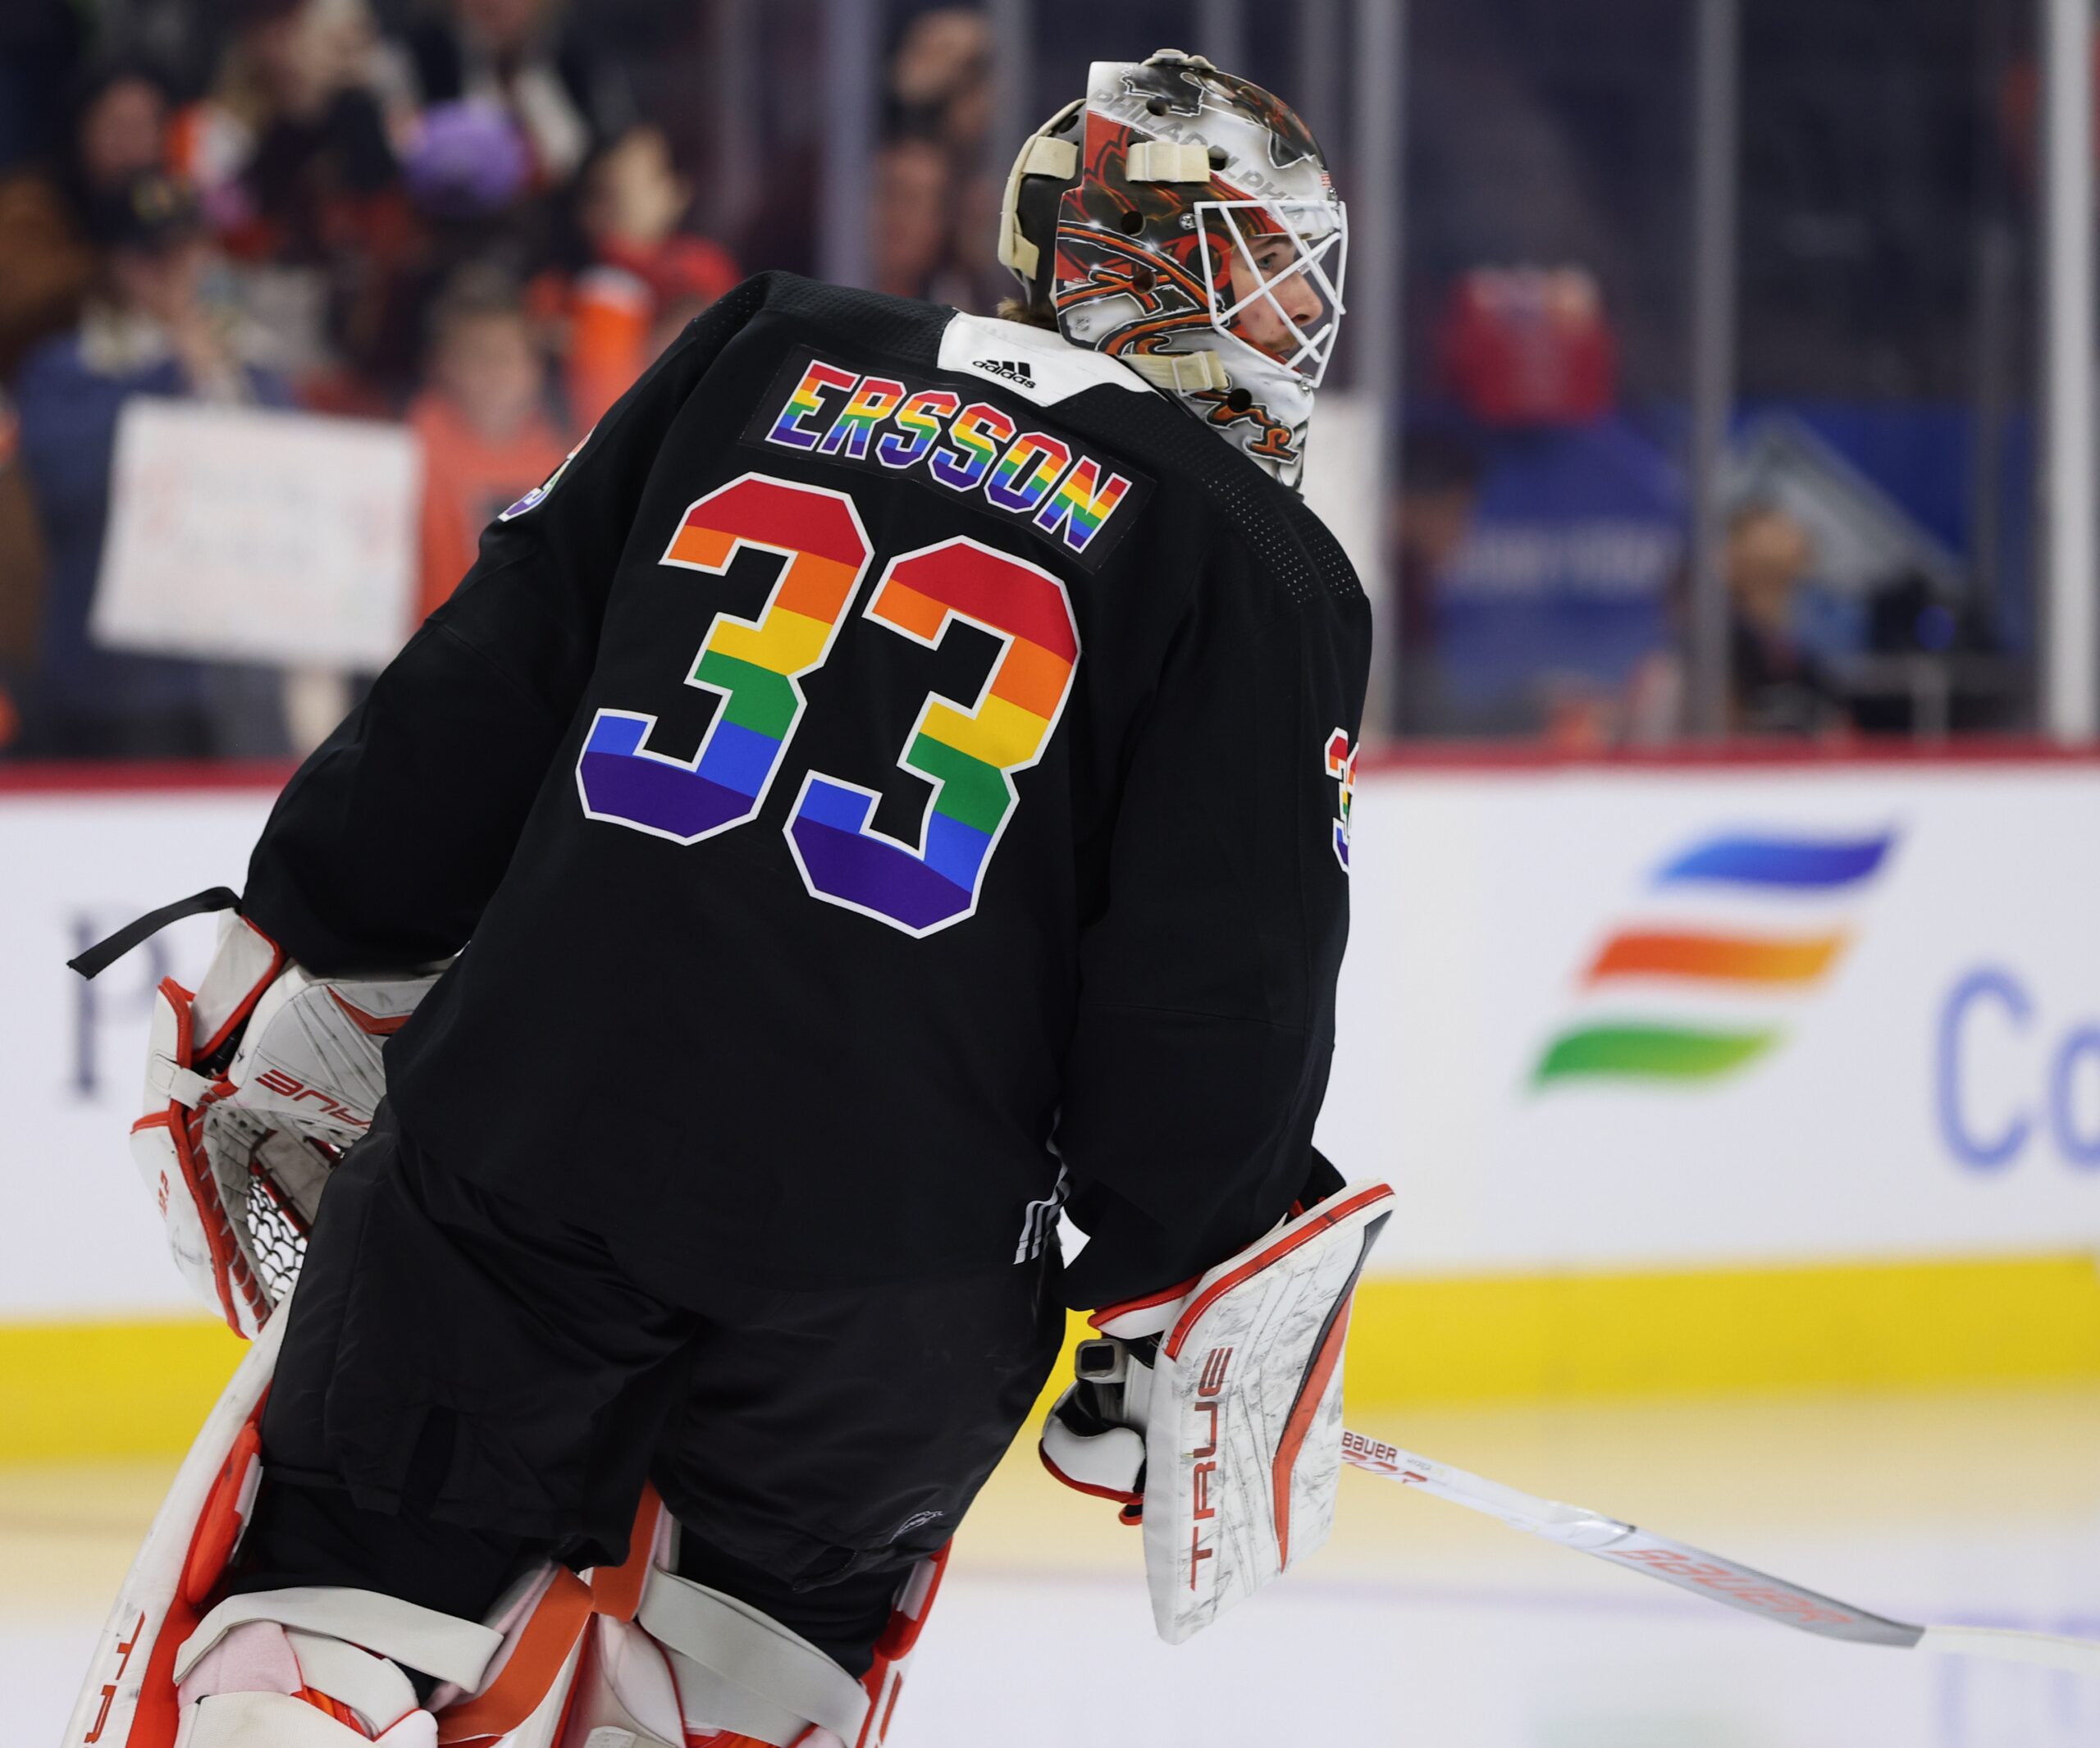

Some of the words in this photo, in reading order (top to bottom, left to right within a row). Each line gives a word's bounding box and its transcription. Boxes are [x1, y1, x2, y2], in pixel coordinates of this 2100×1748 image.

[765, 359, 1133, 554] ERSSON
[971, 360, 1037, 390] adidas
[575, 471, 1082, 939] 33
[255, 1069, 372, 1131] RUE
[1190, 1348, 1234, 1591] TRUE
